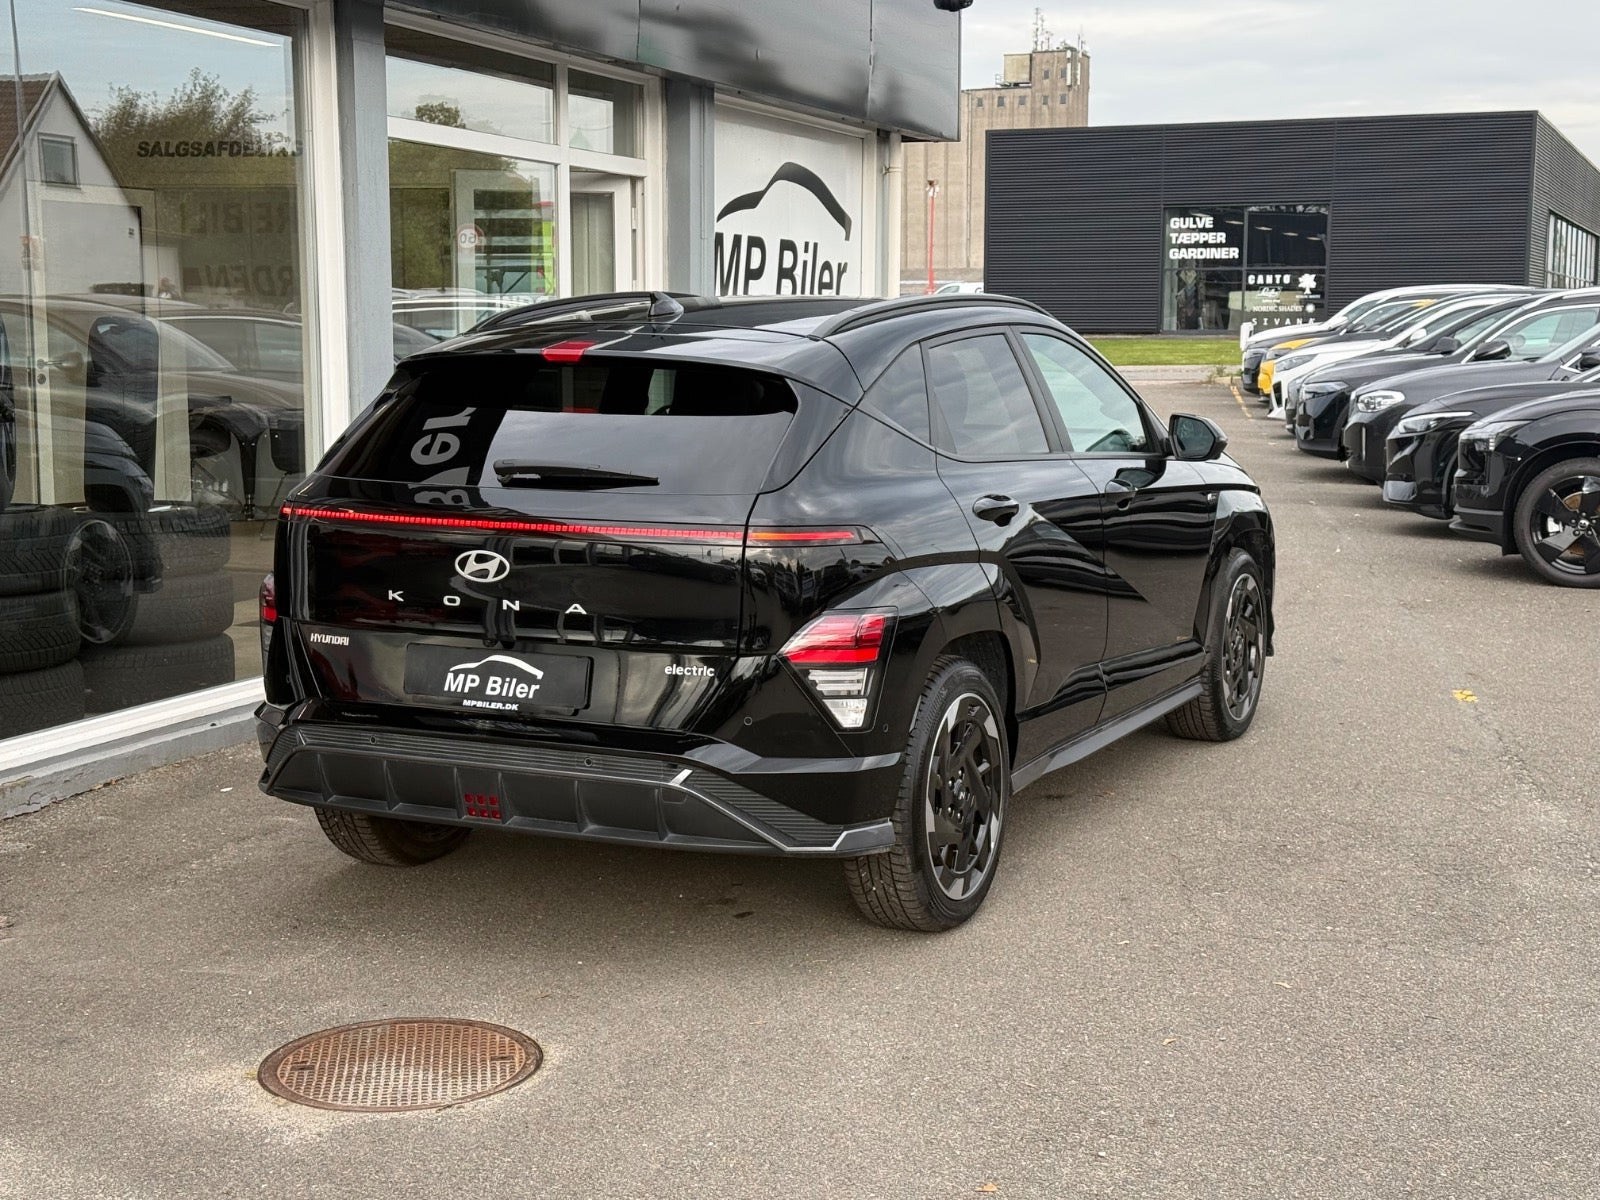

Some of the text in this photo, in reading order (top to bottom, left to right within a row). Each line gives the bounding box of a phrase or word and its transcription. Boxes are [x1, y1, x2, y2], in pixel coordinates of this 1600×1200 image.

[1170, 216, 1214, 229] GULVE
[1169, 232, 1226, 244] TÆPPER
[1169, 247, 1239, 259] GARDINER
[715, 231, 848, 296] MP Biler
[388, 589, 588, 615] KONA
[310, 632, 350, 646] HYUNDAI
[664, 663, 715, 677] electric
[443, 672, 540, 699] MP Biler
[462, 699, 520, 711] MPBILER.DK
